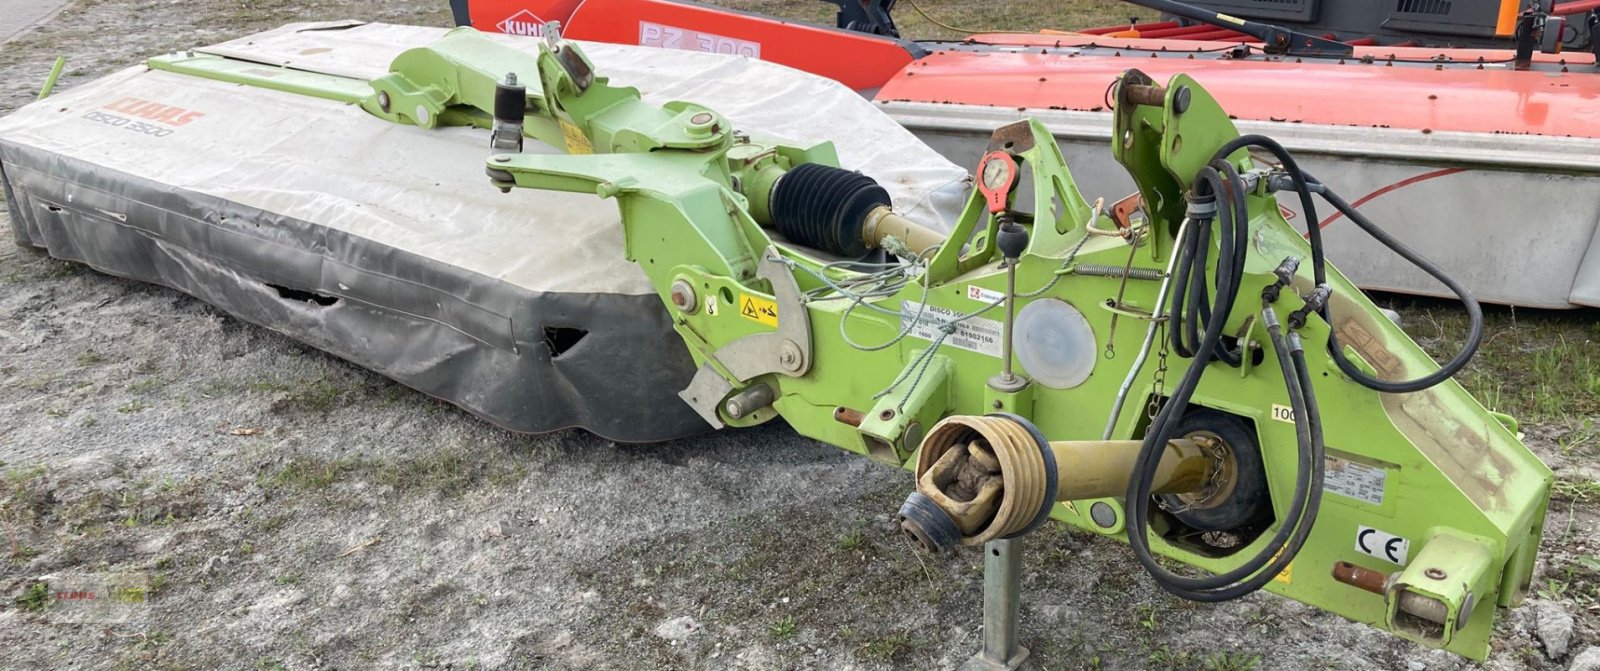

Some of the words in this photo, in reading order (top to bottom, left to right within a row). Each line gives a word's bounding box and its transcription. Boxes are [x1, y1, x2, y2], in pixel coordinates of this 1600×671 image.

[641, 22, 683, 49] PZ
[81, 111, 132, 127] DISCO
[124, 121, 175, 138] 3500
[102, 96, 206, 127] CLAAS
[929, 305, 951, 316] DISCO
[1358, 528, 1403, 563] CE
